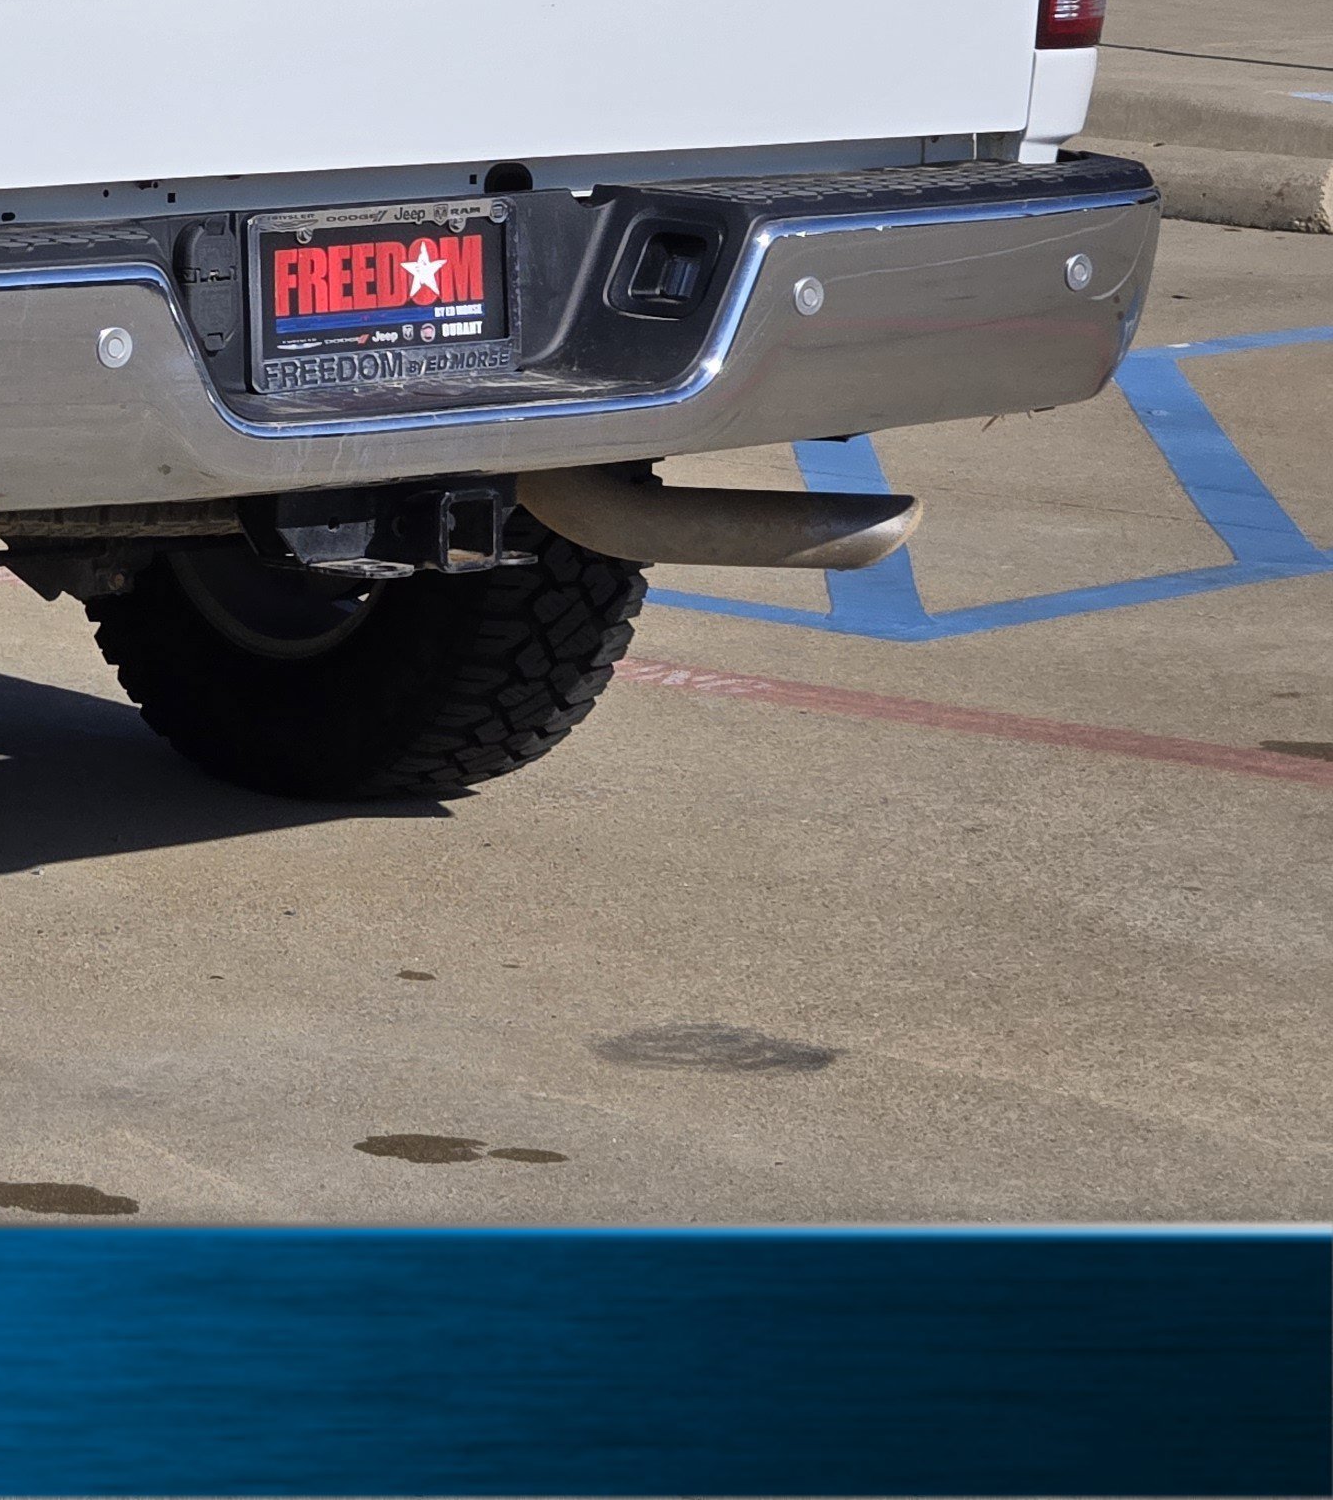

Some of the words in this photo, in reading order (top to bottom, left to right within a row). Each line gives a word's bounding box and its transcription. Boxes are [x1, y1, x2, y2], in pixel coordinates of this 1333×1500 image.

[326, 213, 377, 222] DODGE
[394, 207, 426, 222] Jeep
[450, 206, 481, 216] RAM
[274, 235, 483, 317] FREEDOM
[372, 330, 399, 343] Jeep
[441, 320, 483, 338] DURANT
[264, 351, 404, 390] FREEDOM
[450, 349, 511, 370] MORSE
